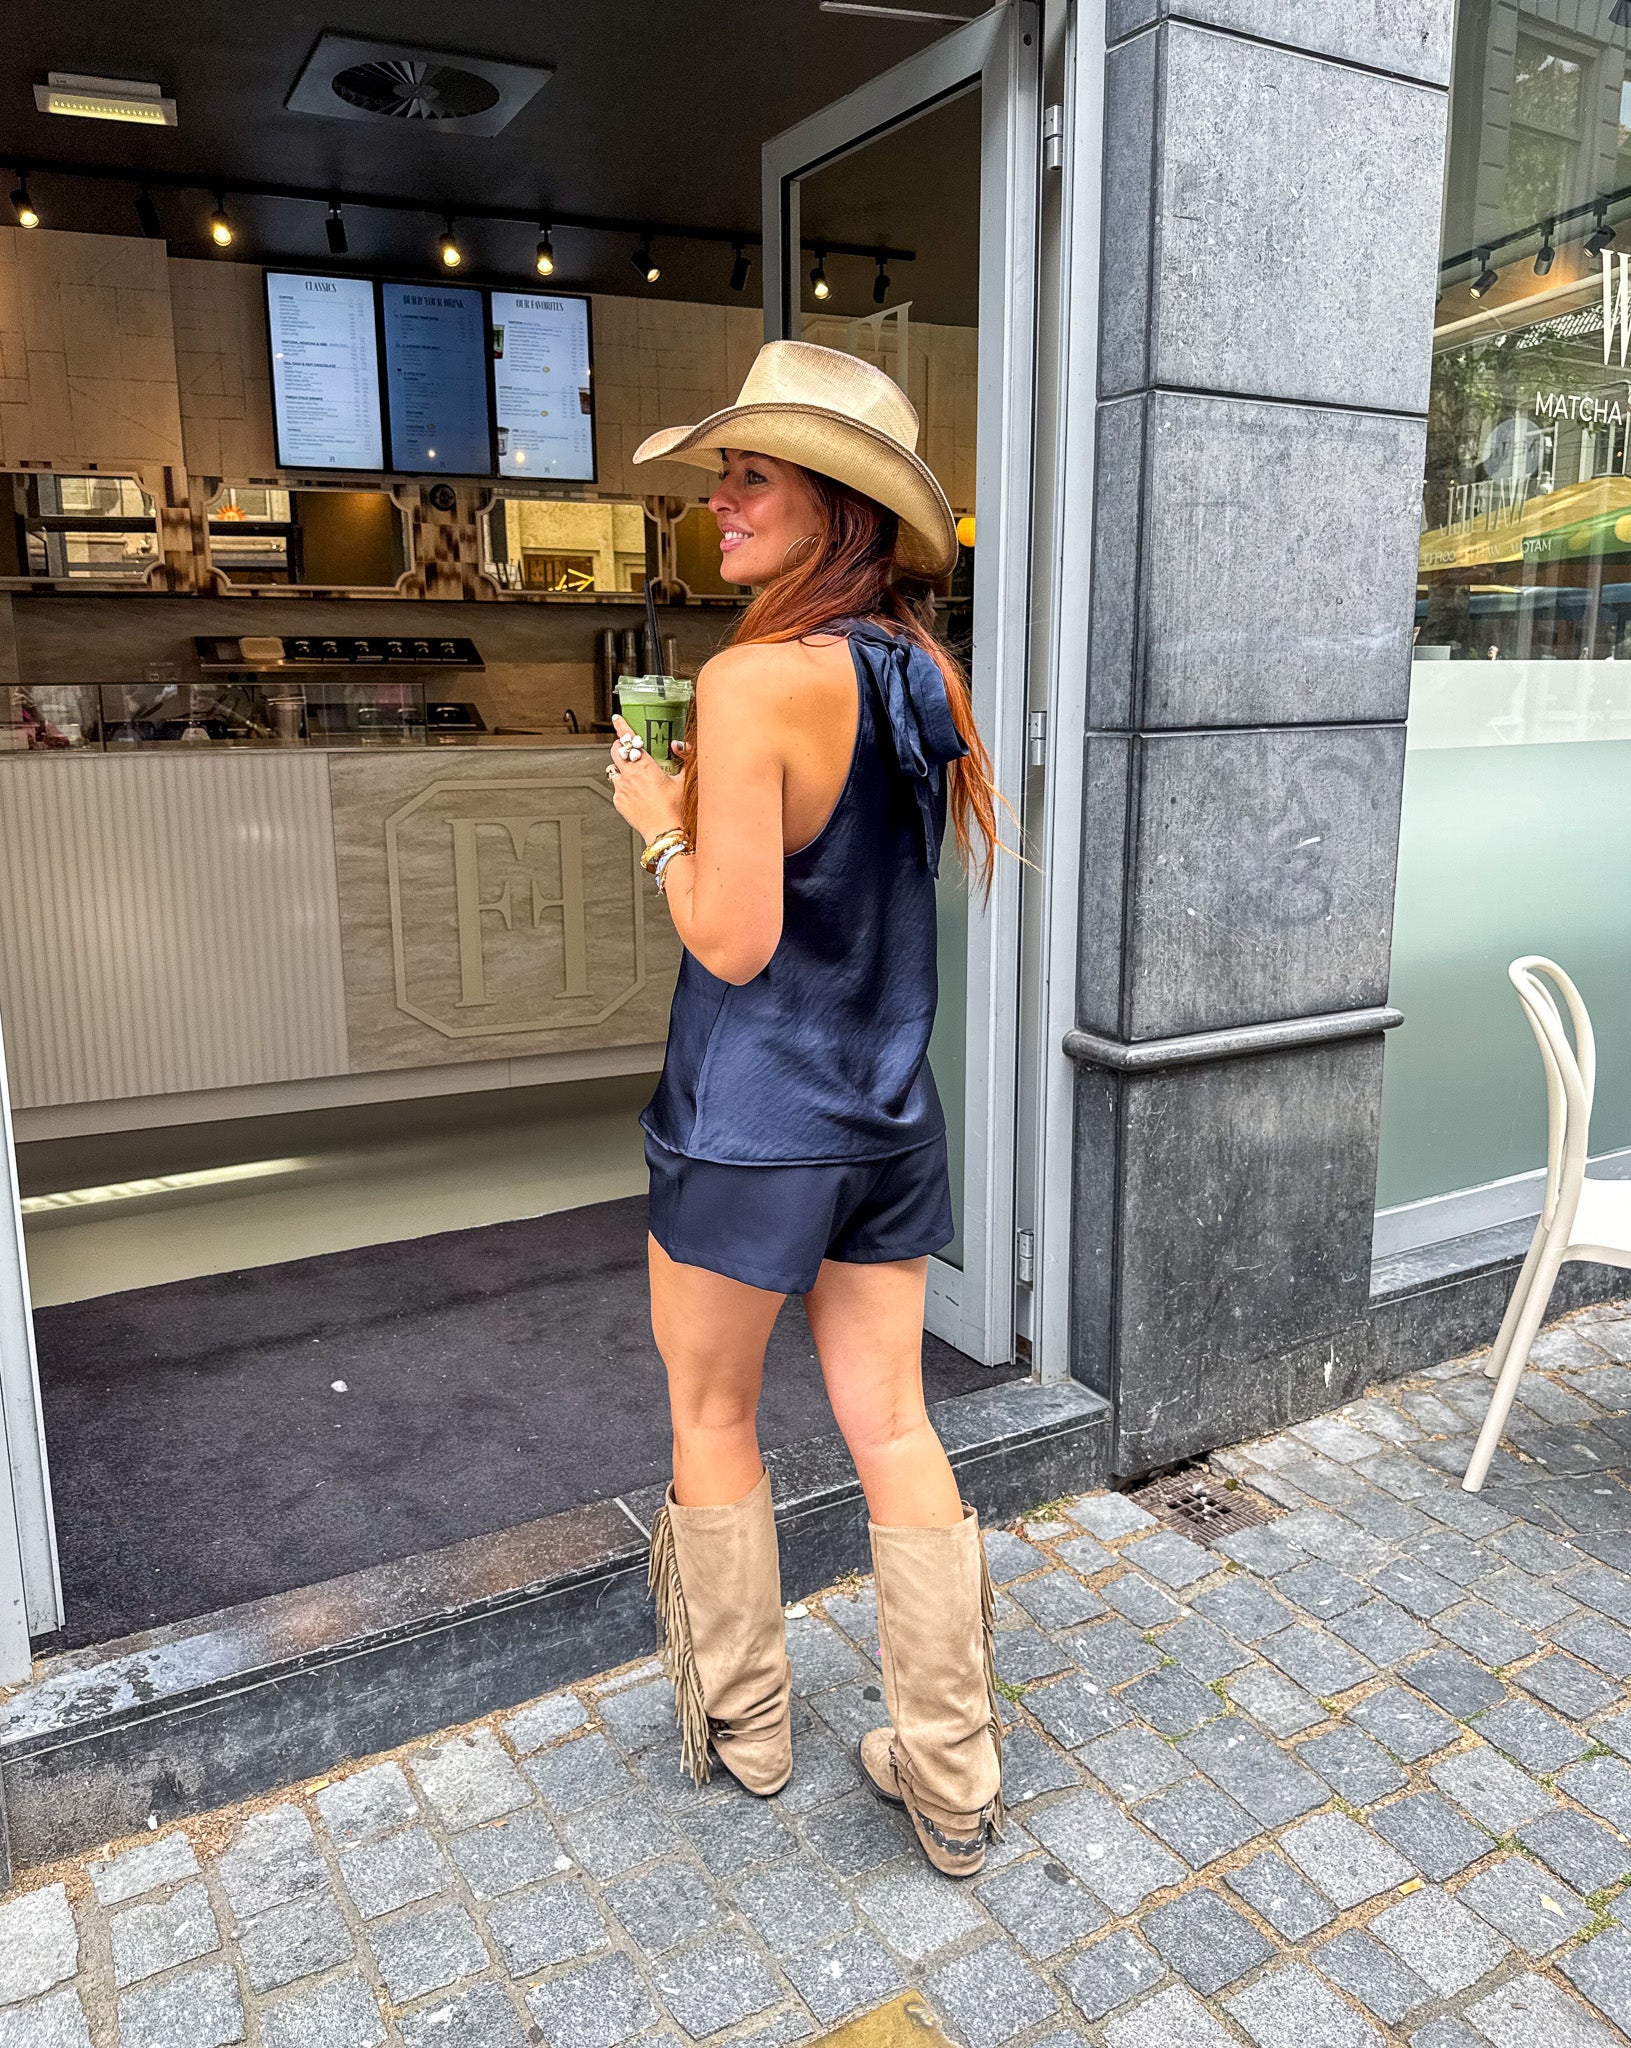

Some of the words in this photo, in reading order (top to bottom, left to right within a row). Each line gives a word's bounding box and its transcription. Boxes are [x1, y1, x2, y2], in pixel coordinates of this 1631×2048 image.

[305, 281, 337, 293] CLASSICS
[515, 298, 530, 309] OUR
[531, 300, 564, 312] FAVORITES
[1535, 391, 1622, 426] MATCHA
